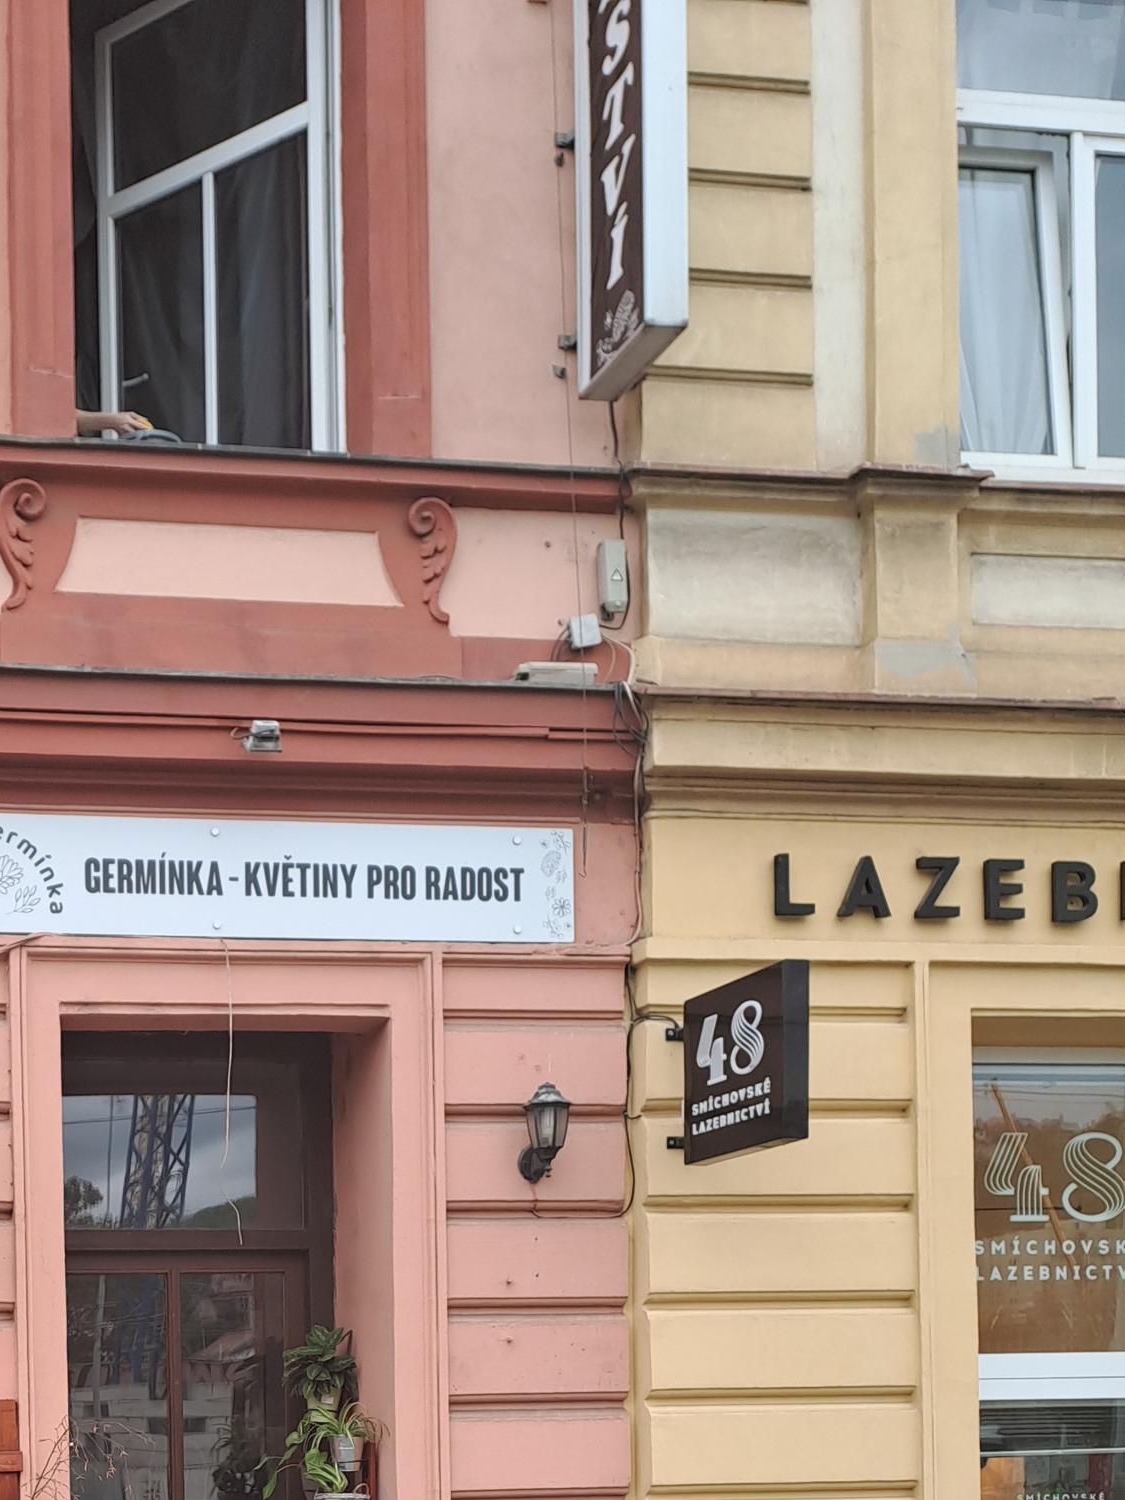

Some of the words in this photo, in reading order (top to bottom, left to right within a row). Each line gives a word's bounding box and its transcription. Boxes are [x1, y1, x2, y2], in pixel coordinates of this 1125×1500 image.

[598, 0, 637, 290] STVÍ
[84, 852, 224, 896] GERMÍNKA
[244, 855, 358, 899] KVĚTINY
[367, 864, 416, 900] PRO
[425, 865, 525, 902] RADOST
[774, 853, 1125, 923] LAZEB
[696, 1000, 765, 1086] 48
[691, 1076, 772, 1116] SMÍCHOVSKÉ
[692, 1097, 771, 1136] LAZEBNICTVÍ
[984, 1132, 1125, 1223] 48
